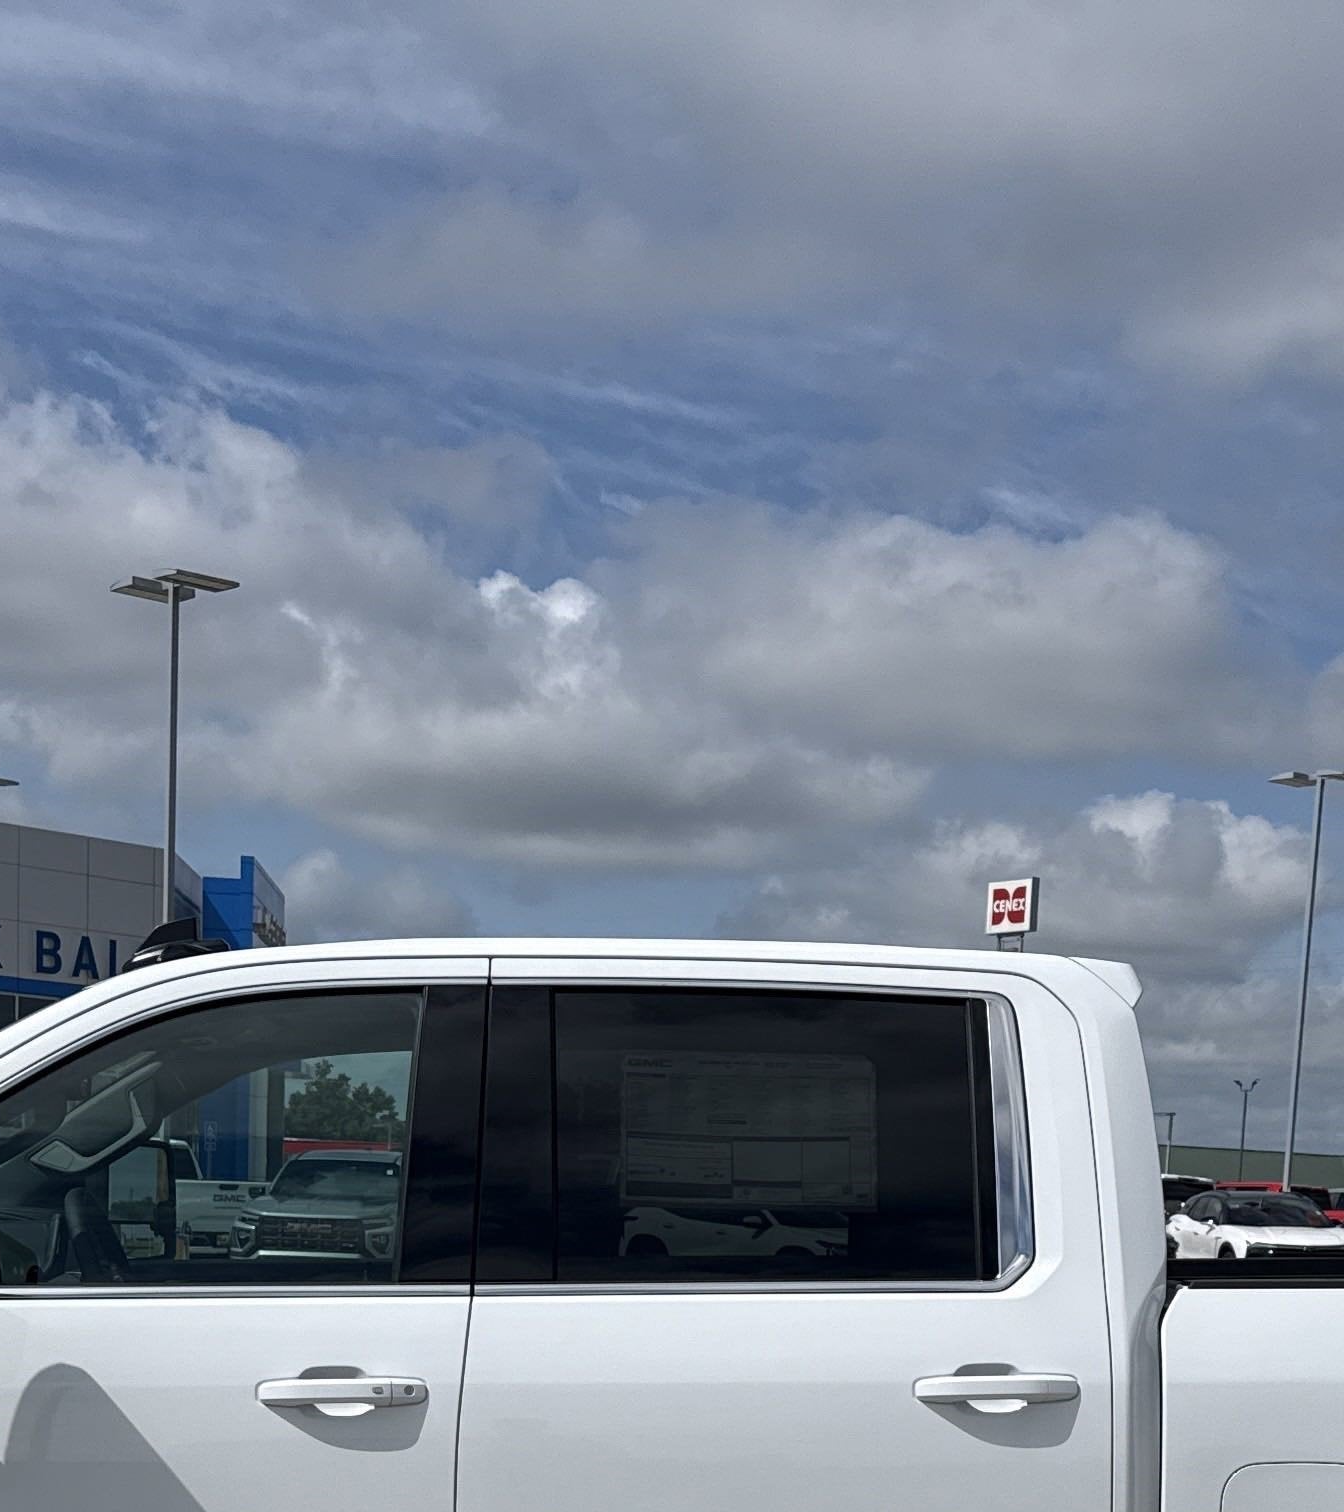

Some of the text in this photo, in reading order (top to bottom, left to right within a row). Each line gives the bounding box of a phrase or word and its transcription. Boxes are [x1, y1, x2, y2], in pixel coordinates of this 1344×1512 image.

[993, 897, 1026, 912] CENEX
[35, 929, 118, 979] BAL
[213, 1193, 247, 1203] GMC
